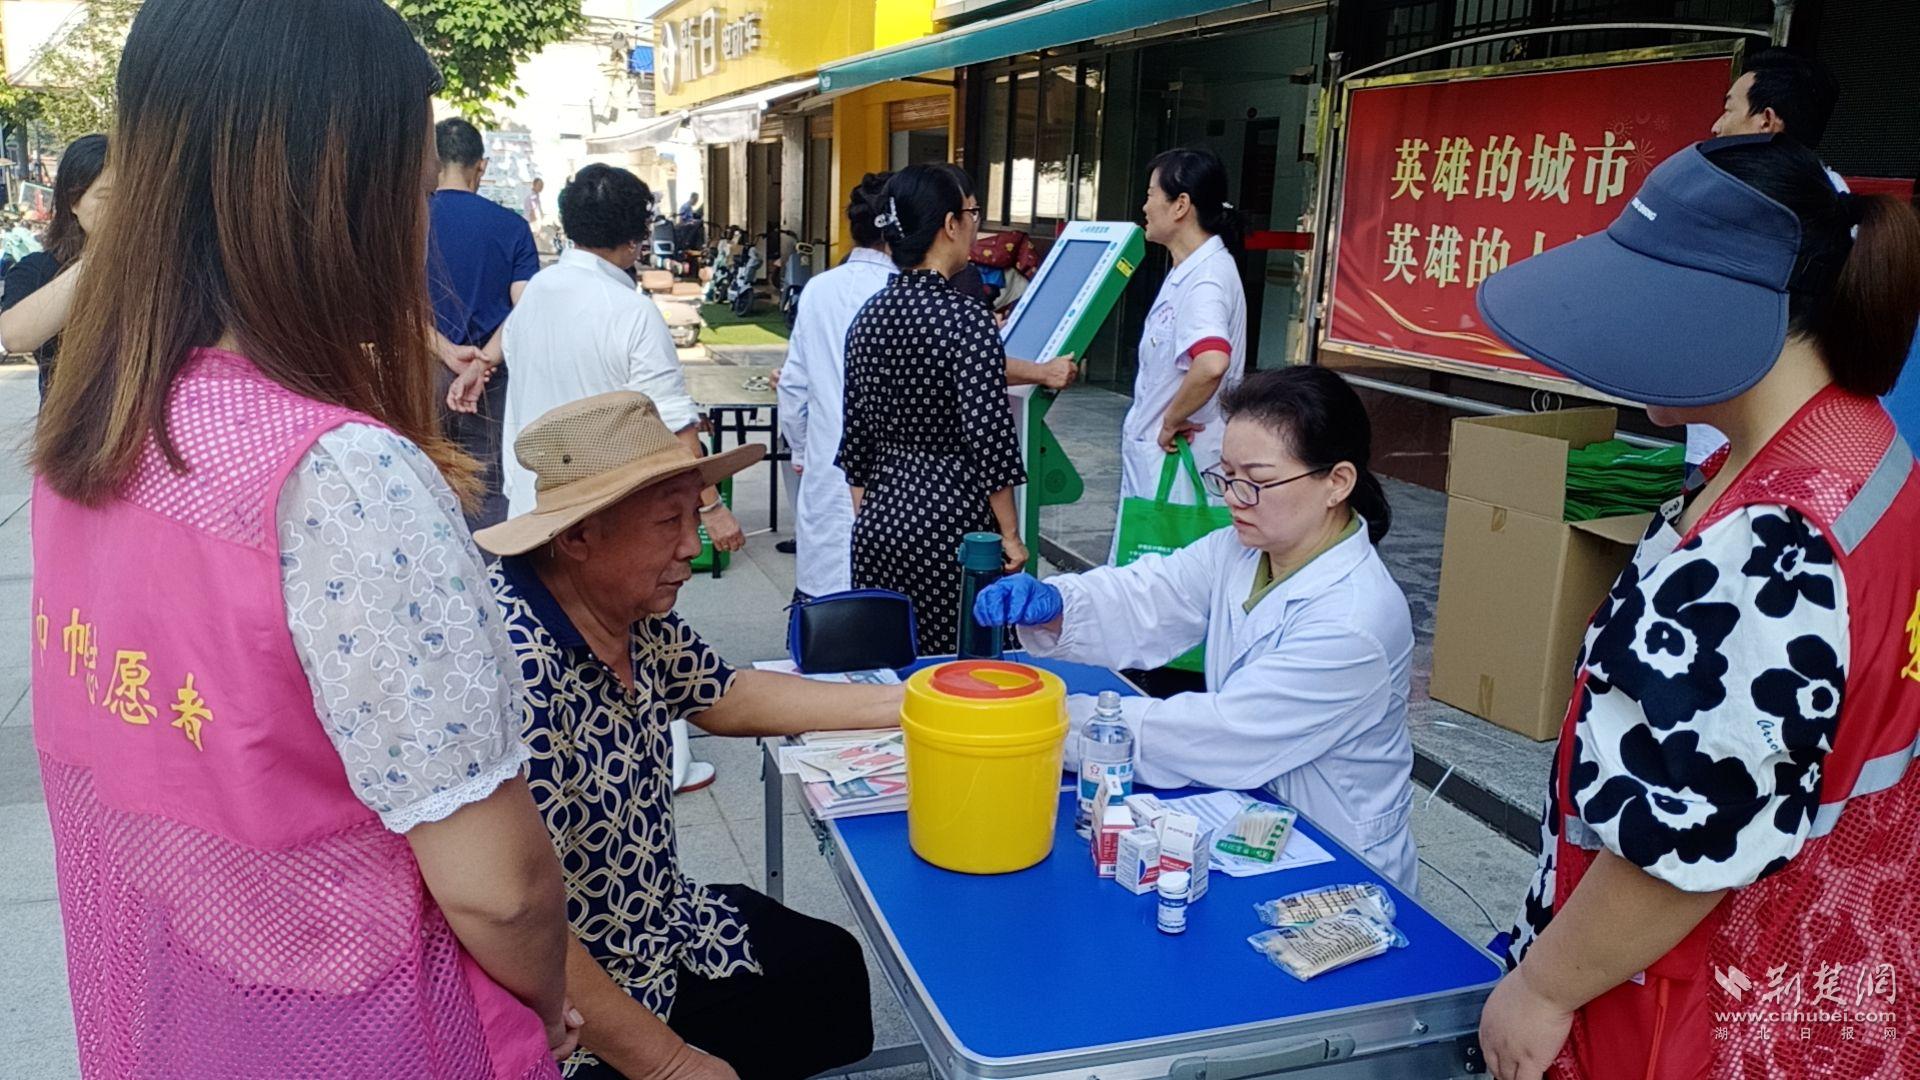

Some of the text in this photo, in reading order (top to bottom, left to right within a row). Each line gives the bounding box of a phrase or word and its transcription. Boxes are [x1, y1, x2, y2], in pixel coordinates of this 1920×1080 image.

[1390, 130, 1636, 206] 英雄的城市
